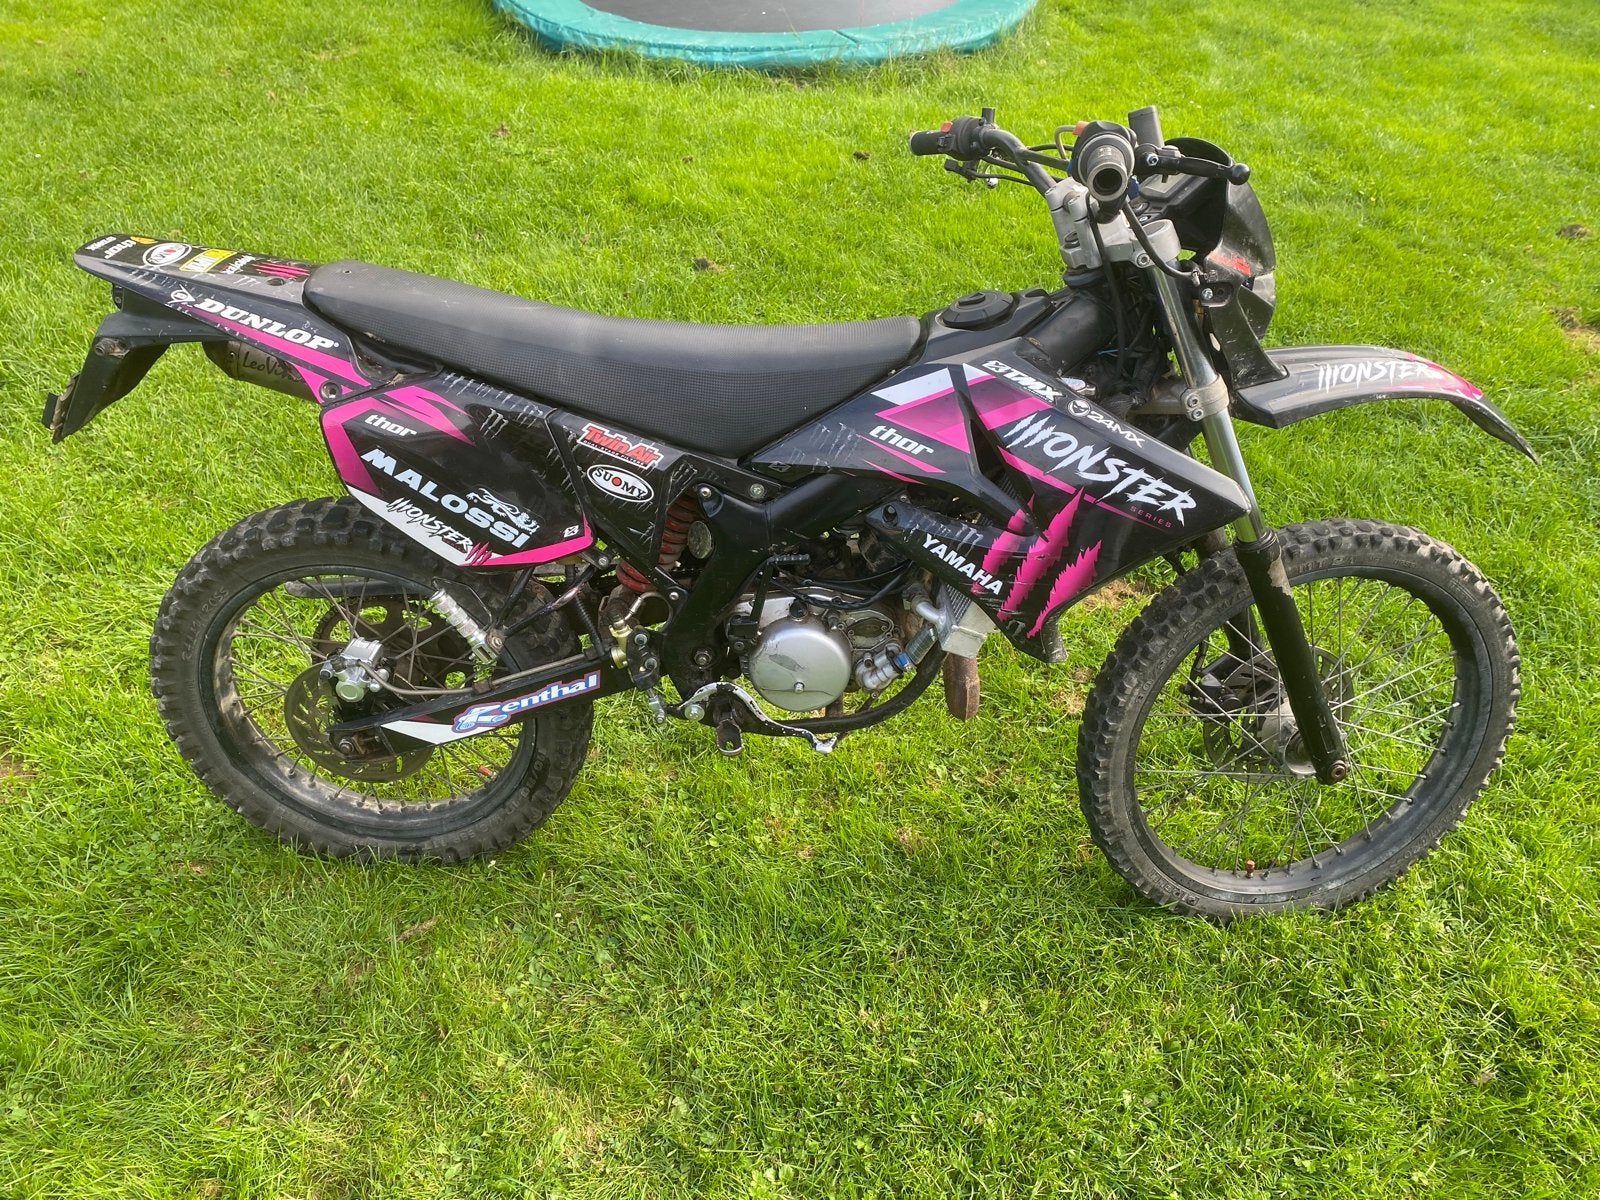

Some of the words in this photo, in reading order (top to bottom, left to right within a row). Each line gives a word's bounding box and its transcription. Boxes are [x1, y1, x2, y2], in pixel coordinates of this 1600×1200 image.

[194, 297, 334, 349] DUNLOP
[1318, 360, 1441, 393] MONSTER
[364, 414, 418, 437] thor
[869, 425, 935, 455] thor
[1088, 410, 1146, 449] 24MX
[594, 467, 646, 498] SUOMY
[1003, 412, 1197, 527] MONSTER
[360, 448, 531, 548] MALOSSI
[1130, 505, 1172, 528] SERIES
[386, 497, 474, 552] MONSTER
[922, 533, 1003, 595] YAMAHA
